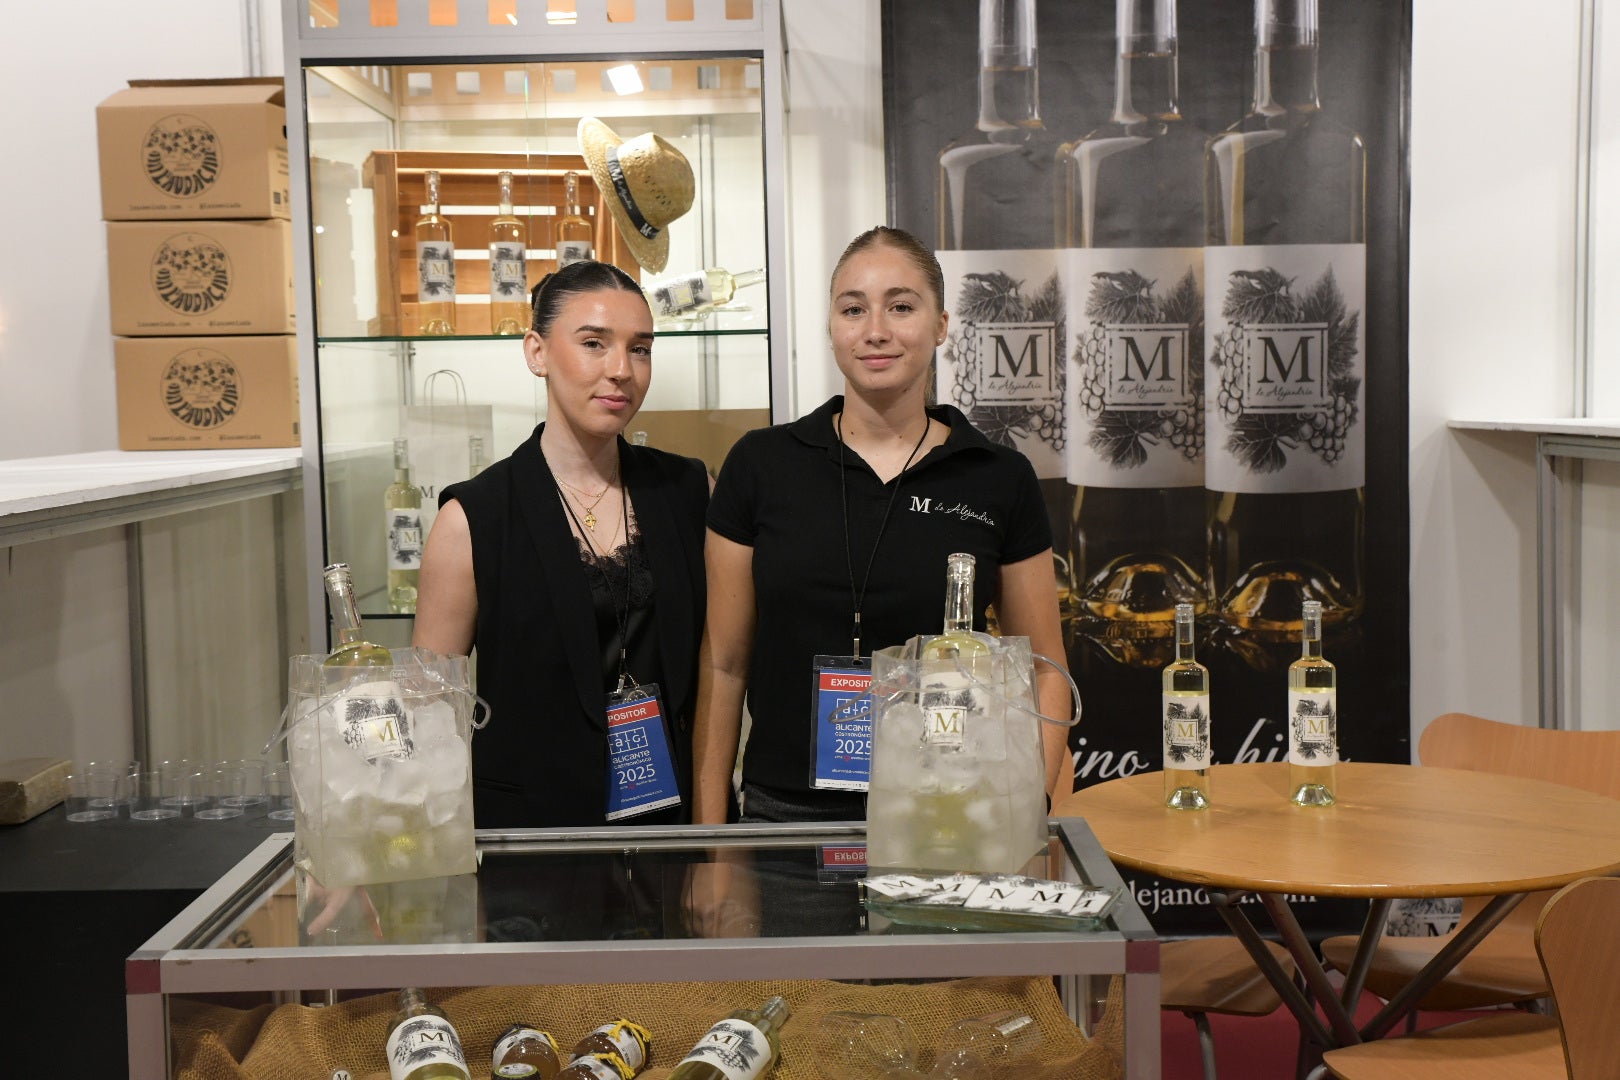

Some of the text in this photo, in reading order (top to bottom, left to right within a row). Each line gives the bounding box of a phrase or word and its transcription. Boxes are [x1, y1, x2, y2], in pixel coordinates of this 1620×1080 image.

[432, 263, 446, 276] M
[505, 263, 519, 276] M
[989, 334, 1043, 378] M
[1118, 336, 1176, 382] M
[1257, 336, 1315, 383] M
[420, 486, 435, 499] M
[909, 495, 932, 514] M
[404, 532, 417, 543] M
[934, 712, 960, 734] M
[1177, 722, 1195, 738] M
[1307, 719, 1325, 734] M
[371, 720, 397, 744] M
[834, 738, 872, 755] 2025
[1073, 737, 1149, 778] ino
[616, 763, 656, 785] 2025
[420, 1032, 445, 1043] M
[705, 1033, 732, 1044] M
